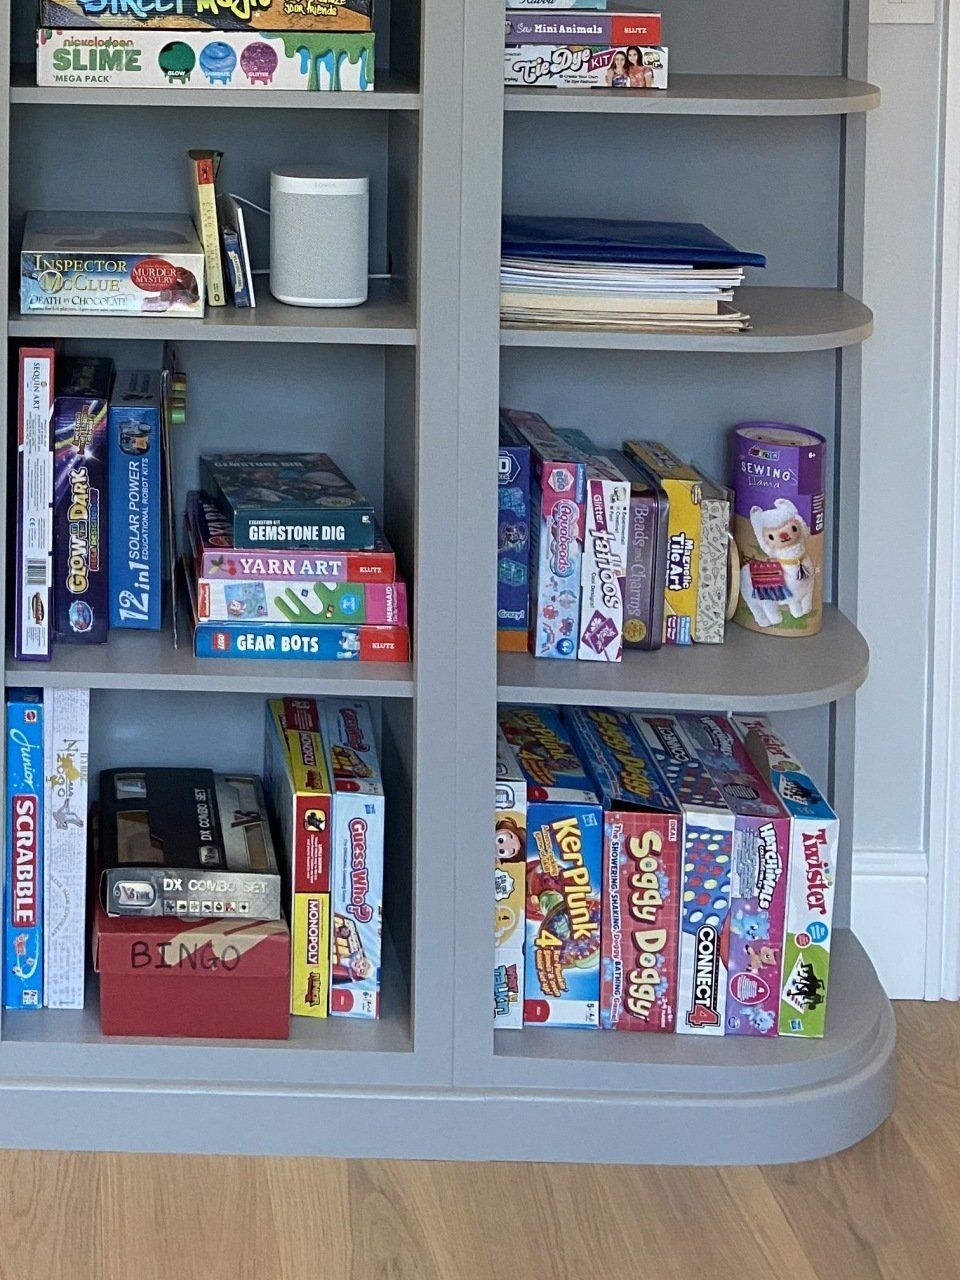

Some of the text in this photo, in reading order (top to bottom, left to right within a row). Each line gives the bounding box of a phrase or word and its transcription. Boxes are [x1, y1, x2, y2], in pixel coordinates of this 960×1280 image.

[534, 22, 558, 34] Mini
[558, 23, 603, 35] Animals
[623, 26, 648, 34] KLUTZ
[62, 36, 135, 50] nickelodeon
[52, 48, 143, 73] SLIME
[512, 47, 593, 84] Tie Dye
[590, 54, 611, 69] KIT
[32, 253, 128, 273] INSPECTOR
[132, 268, 177, 279] MURDER
[135, 276, 175, 287] MYSTERY
[32, 362, 41, 393] SEQUIN
[32, 394, 41, 410] ART
[740, 461, 792, 482] SEWING
[128, 460, 141, 560] SOLAR POWER
[141, 457, 150, 560] EDUCATIONAL ROBOT KITS
[248, 525, 346, 542] GEMSTONE DIG
[556, 503, 573, 574] Aquabeads
[589, 493, 622, 610] Glitter tattoos
[627, 506, 649, 617] Beads and Charms
[669, 532, 686, 591] Tile Art
[238, 558, 342, 577] YARN ART
[359, 566, 382, 574] KLUTZ
[682, 538, 695, 590] Magnetic
[236, 633, 319, 652] GEAR BOTS
[371, 642, 396, 650] KLUTZ
[668, 819, 678, 842] IDEAL
[16, 799, 35, 923] SCRABBLE
[801, 828, 829, 916] Twister
[163, 877, 269, 894] DX COMBO SET
[307, 899, 319, 965] MONOPOLY
[609, 824, 622, 1024] The SHOWERING, SHAKING, Doggy BATHING Game!
[534, 928, 564, 949] 4
[130, 940, 241, 972] BINGO
[685, 926, 720, 1029] CONNECT 4
